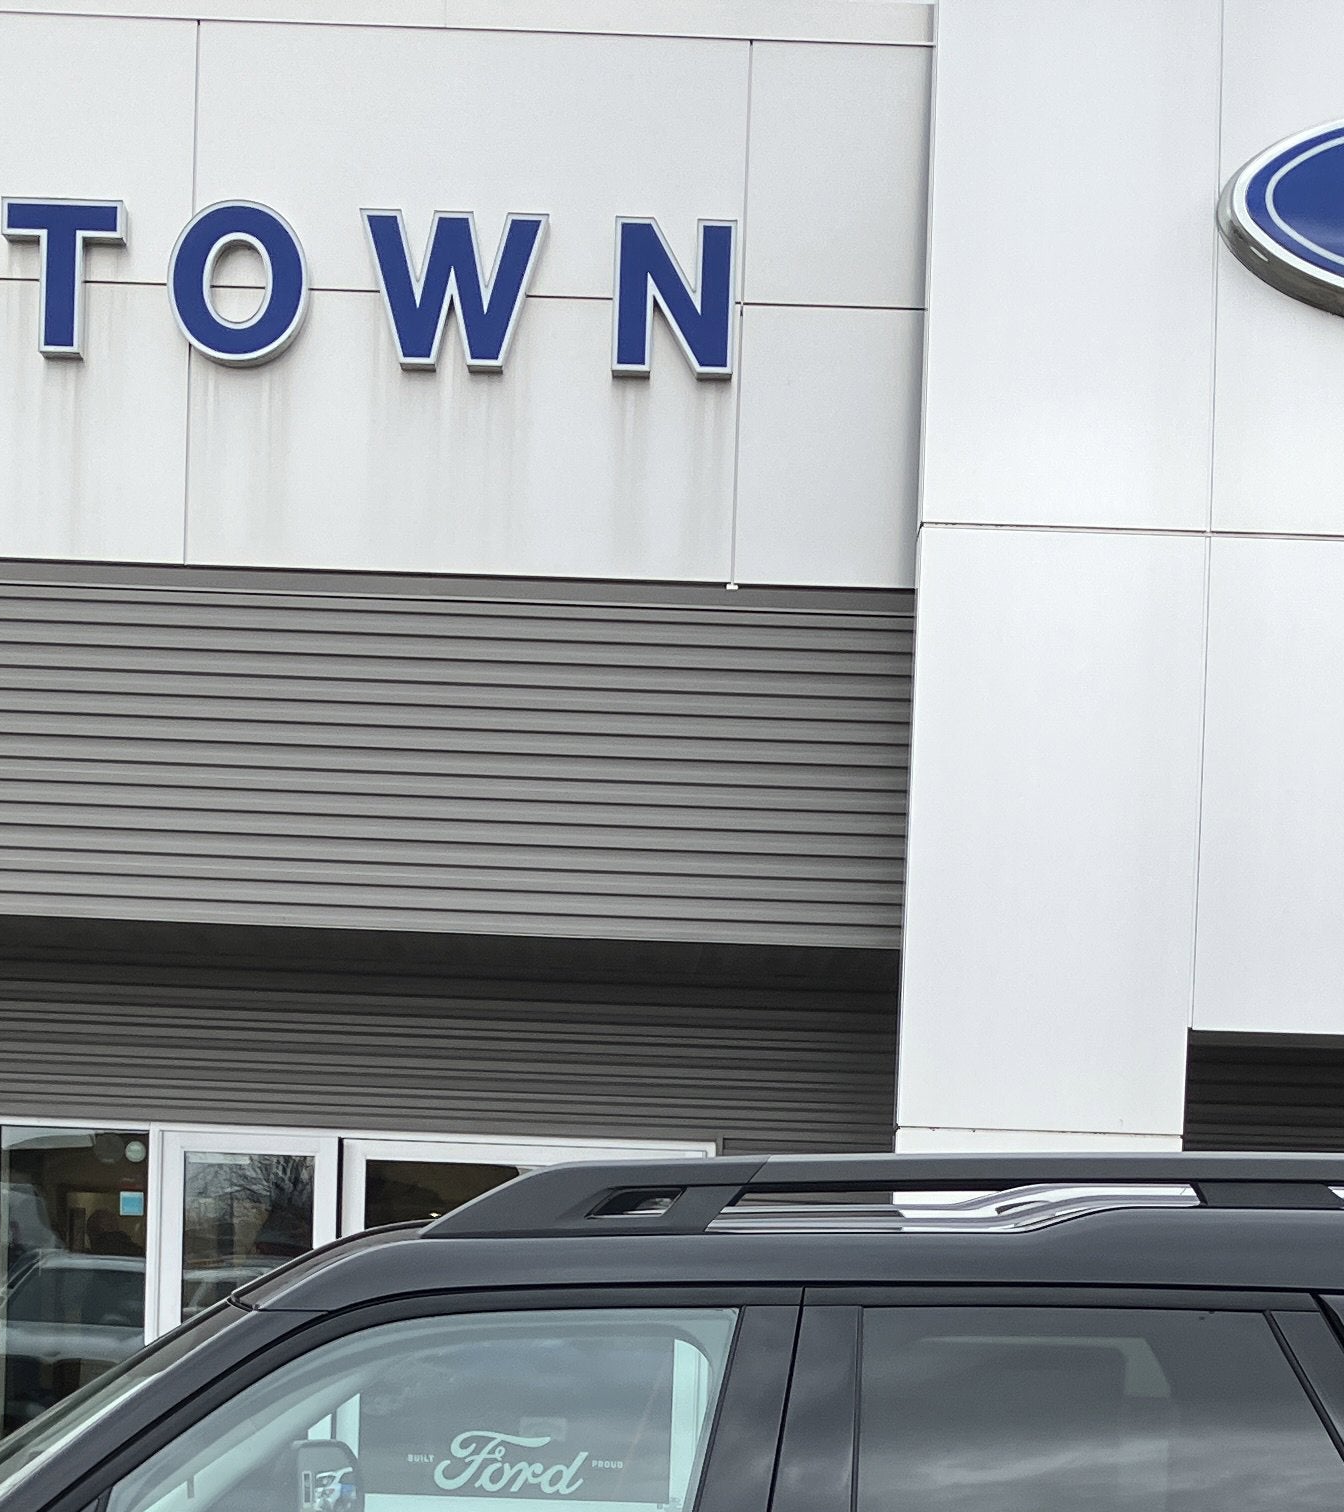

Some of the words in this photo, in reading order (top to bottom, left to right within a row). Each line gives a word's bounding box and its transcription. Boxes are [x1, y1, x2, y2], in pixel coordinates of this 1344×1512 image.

[407, 1453, 435, 1463] BUILT
[433, 1430, 589, 1495] Ford
[591, 1459, 624, 1470] PROUD
